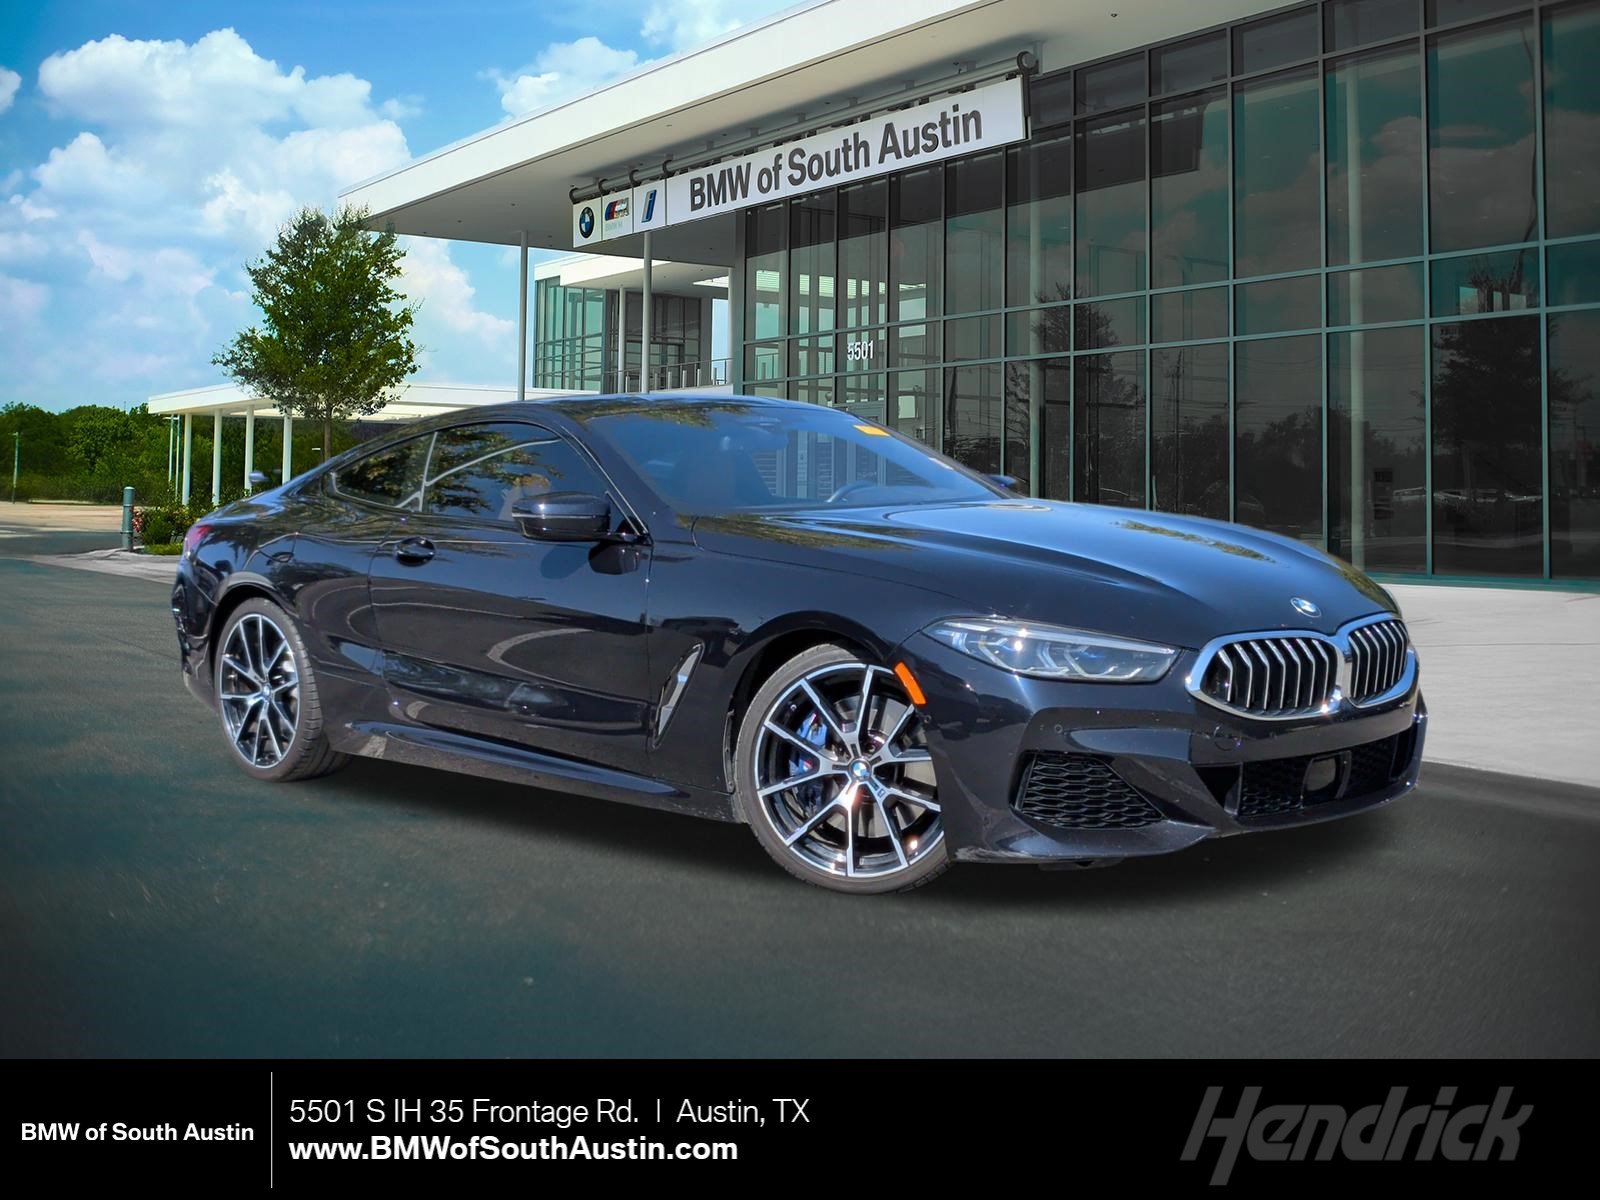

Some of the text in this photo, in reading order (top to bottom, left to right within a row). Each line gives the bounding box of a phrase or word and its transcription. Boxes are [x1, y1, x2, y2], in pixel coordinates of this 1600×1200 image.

[689, 162, 752, 211] BMW
[757, 153, 783, 194] of
[787, 132, 871, 186] South
[878, 104, 983, 164] Austin
[847, 340, 874, 361] 5501
